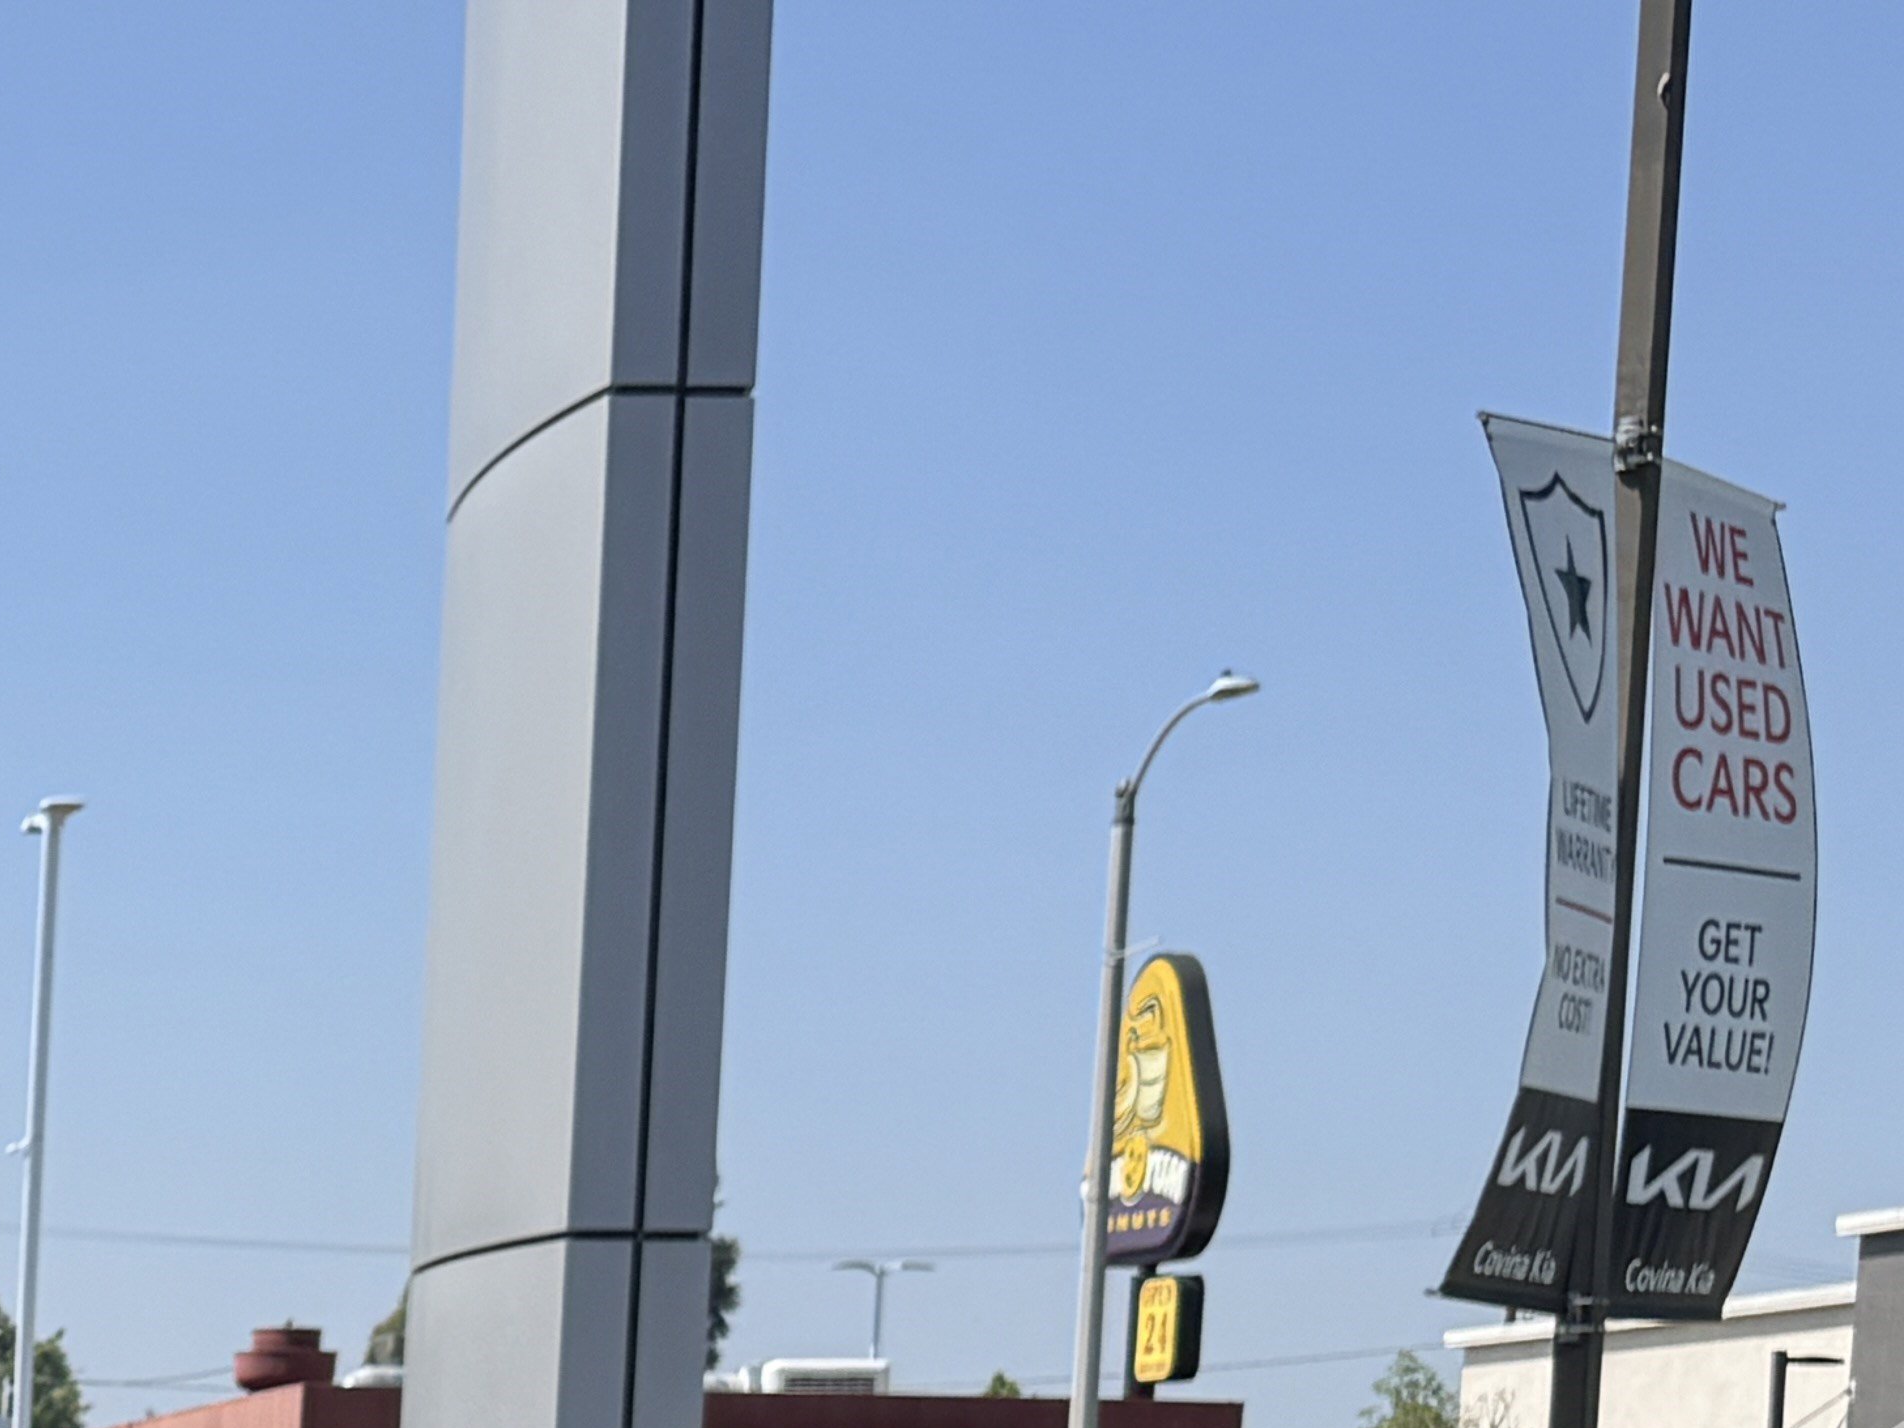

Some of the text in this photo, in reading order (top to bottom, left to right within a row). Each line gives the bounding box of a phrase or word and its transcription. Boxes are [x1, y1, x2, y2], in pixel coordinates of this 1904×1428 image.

[1690, 510, 1754, 587] WE
[1664, 582, 1786, 669] WANT
[1675, 663, 1791, 744] USED
[1562, 780, 1612, 832] LIFETIME
[1671, 747, 1797, 825] CARS
[1553, 944, 1605, 994] NO EXTRA
[1698, 919, 1763, 967] GET
[1681, 969, 1770, 1022] YOUR
[1664, 1021, 1774, 1075] VALUE!
[1473, 1240, 1557, 1285] Covina Kia
[1625, 1258, 1715, 1296] Covina Kia
